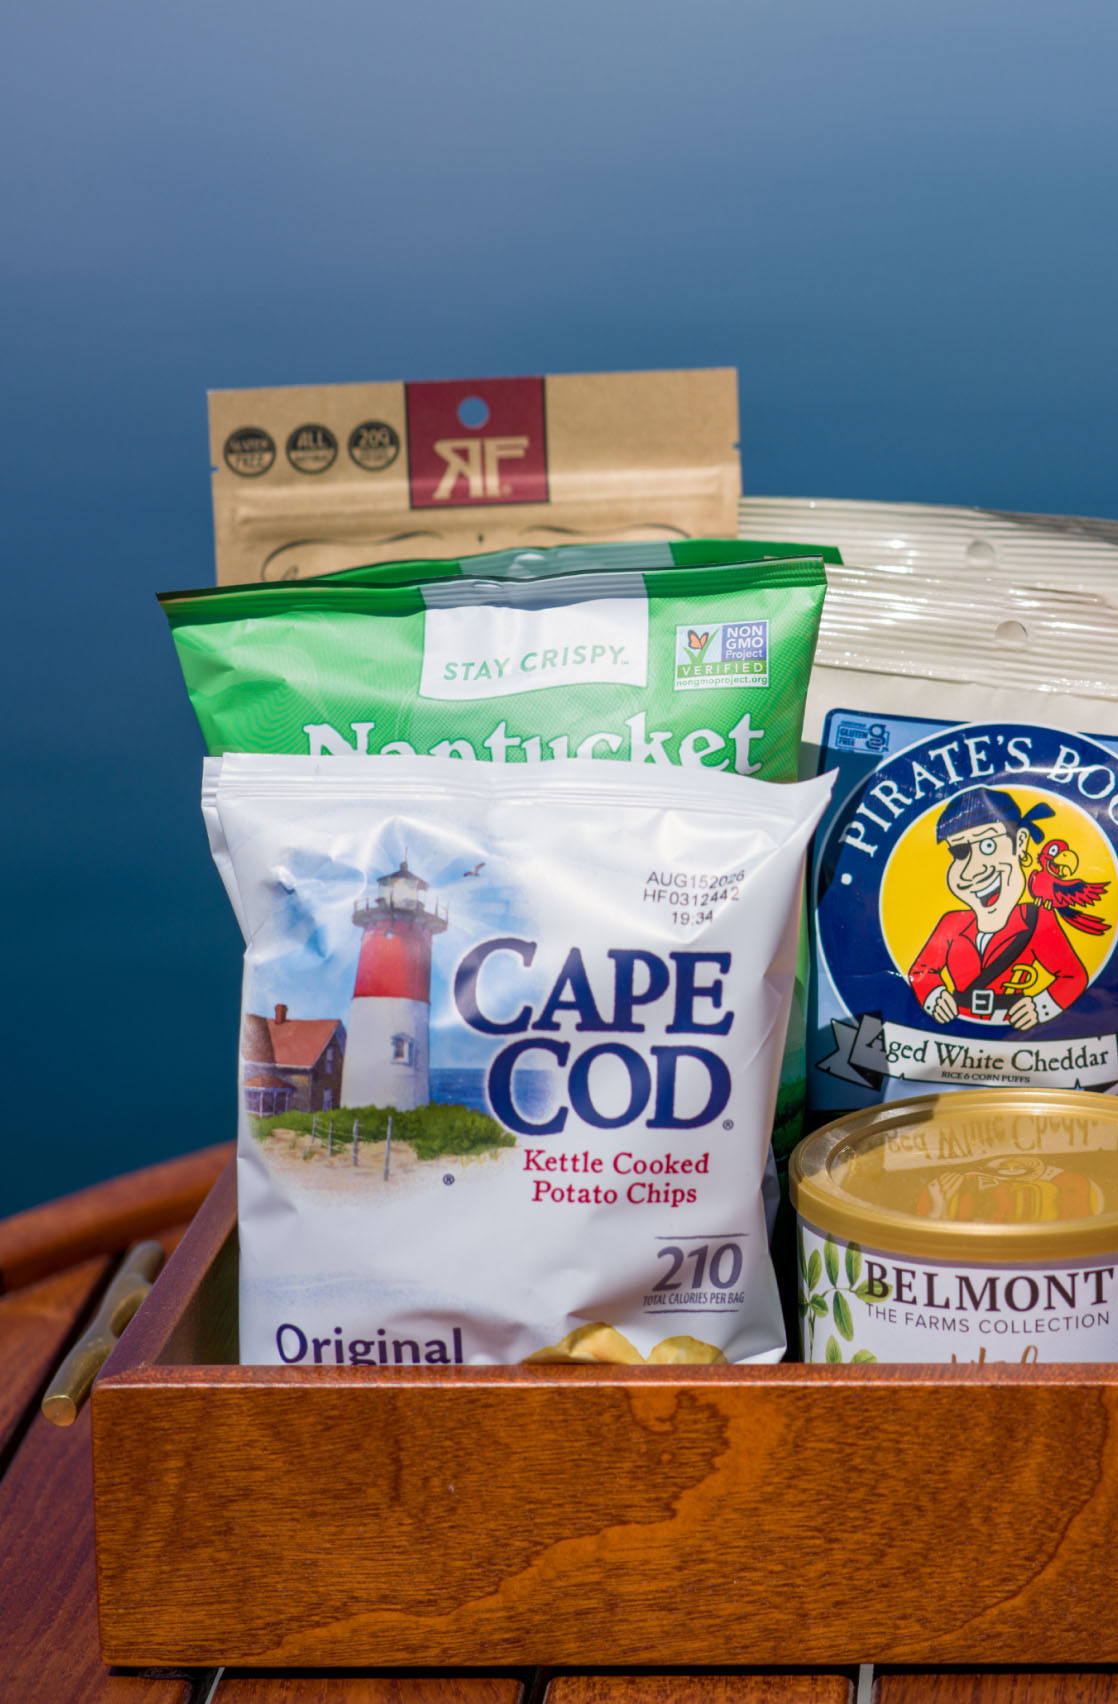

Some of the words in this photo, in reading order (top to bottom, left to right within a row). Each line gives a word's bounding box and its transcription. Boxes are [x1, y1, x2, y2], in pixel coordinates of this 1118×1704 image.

[726, 637, 764, 650] GMO
[727, 625, 763, 638] NON
[725, 649, 763, 661] Project
[443, 658, 510, 681] STAY
[676, 676, 768, 687] nongmoproject.org
[682, 662, 764, 676] VERIFIED
[838, 735, 1033, 858] PIRATE'S
[454, 937, 735, 1036] CAPE
[865, 1030, 929, 1063] Aged
[934, 1041, 1004, 1071] White
[1011, 1042, 1109, 1072] Cheddar
[488, 1037, 732, 1136] COD
[941, 1071, 963, 1079] RICE
[971, 1073, 1000, 1081] CORN
[1001, 1074, 1031, 1083] PUFFS
[523, 1149, 603, 1174] Kettle
[613, 1152, 710, 1174] Cooked
[531, 1180, 617, 1204] Potato
[627, 1182, 697, 1207] Chips
[652, 1243, 744, 1292] 210
[643, 1295, 667, 1306] TOTAL
[668, 1292, 708, 1305] CALORIES
[710, 1292, 726, 1304] PER
[727, 1291, 745, 1304] BAG
[863, 1259, 1115, 1313] BELMONT
[866, 1303, 898, 1324] THE
[904, 1311, 969, 1333] FARMS
[979, 1311, 1111, 1334] COLLECTION
[276, 1323, 464, 1365] Original
